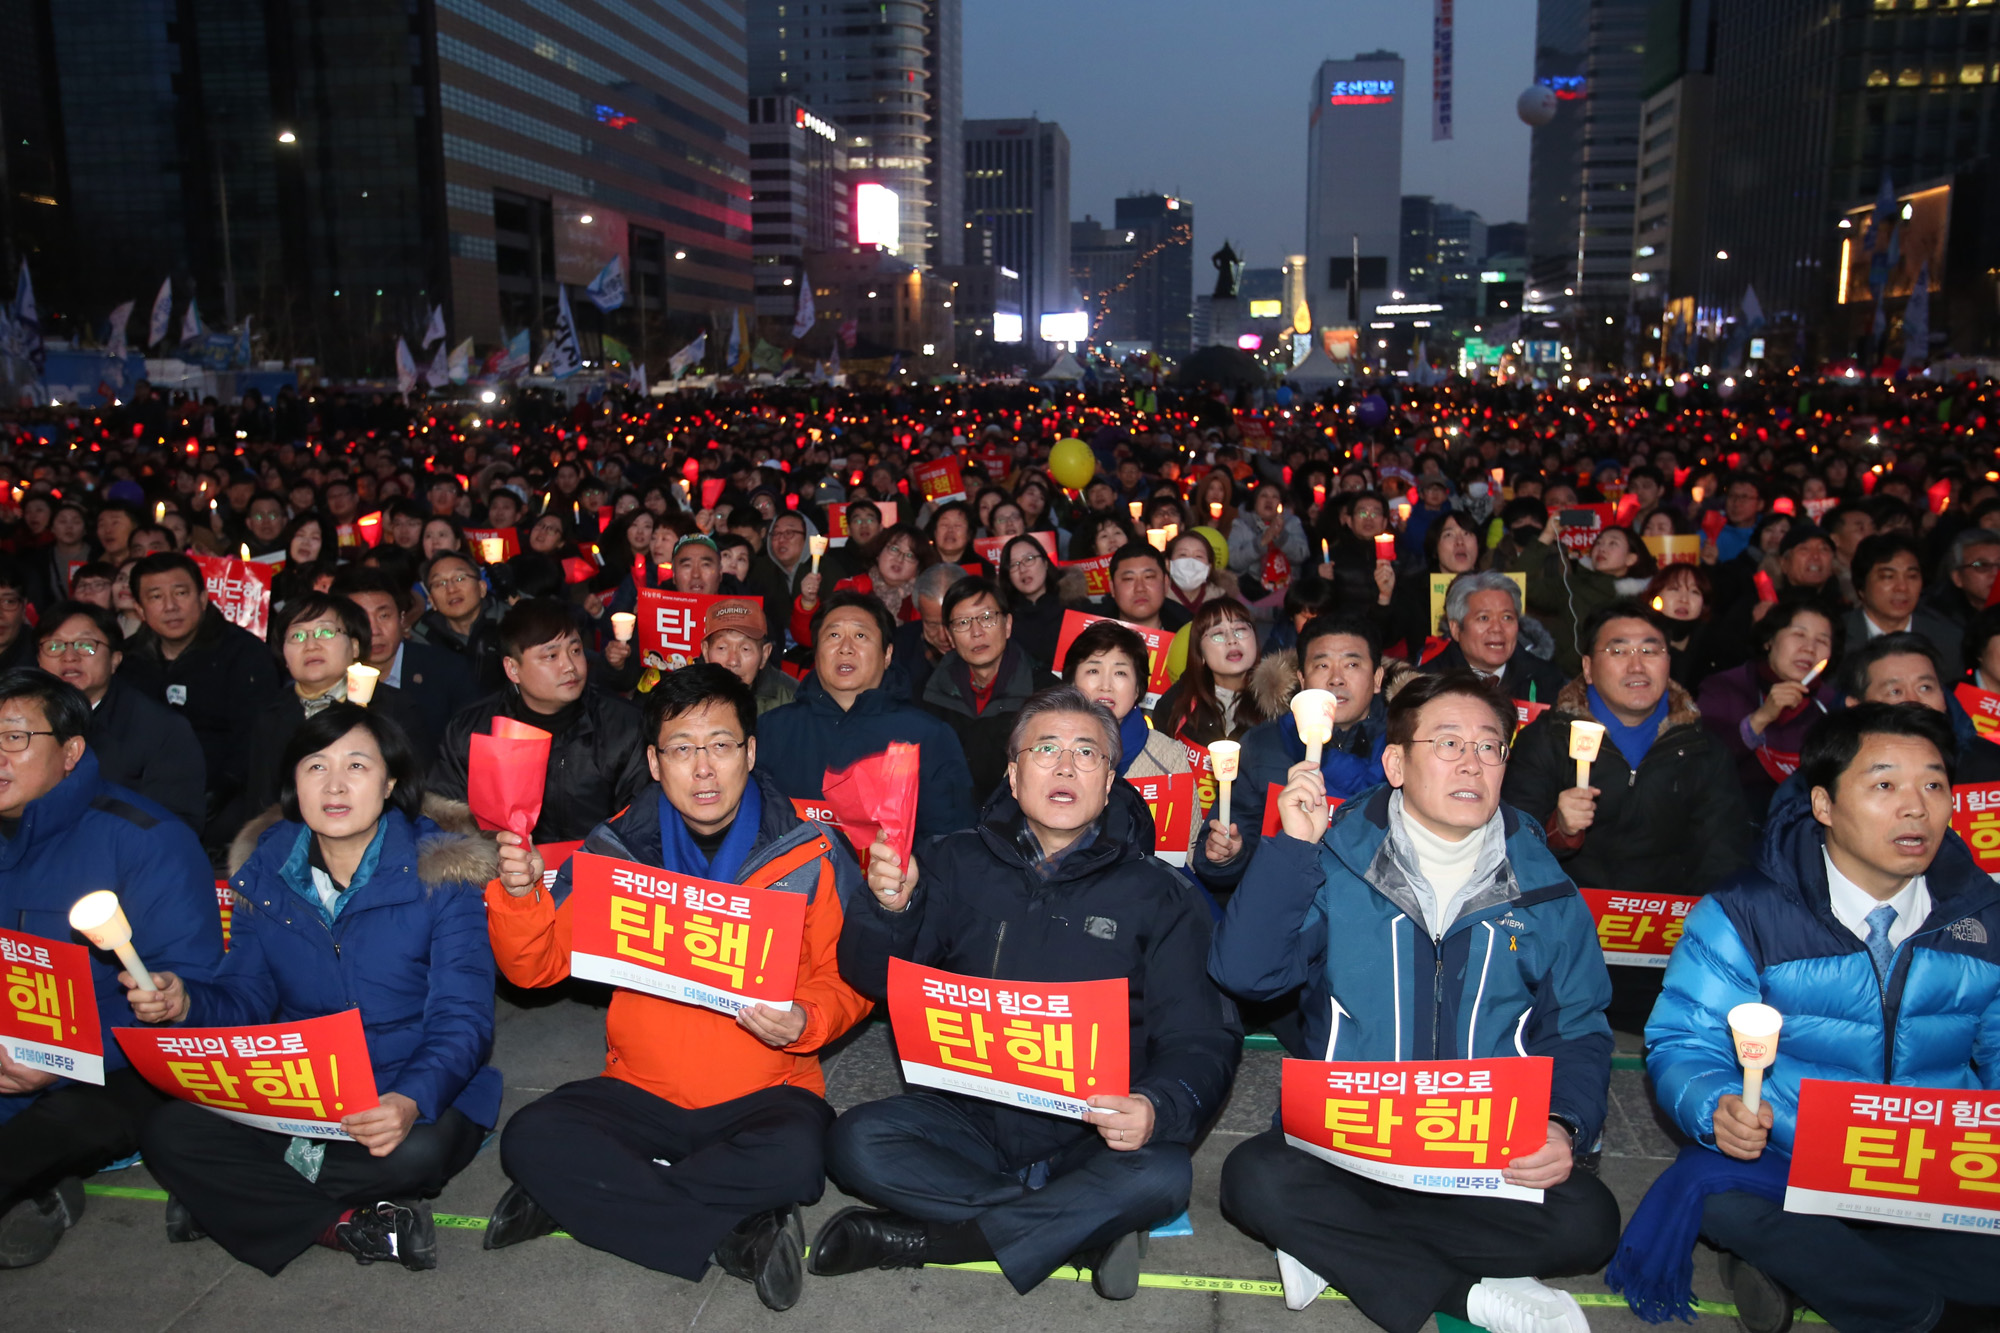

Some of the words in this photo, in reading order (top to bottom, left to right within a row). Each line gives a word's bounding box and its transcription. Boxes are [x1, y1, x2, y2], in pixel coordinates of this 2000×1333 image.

[1330, 79, 1395, 96] 조선일보
[206, 577, 263, 601] 박근혜
[716, 607, 748, 617] JOURNEY
[611, 868, 677, 905] 국민의
[683, 885, 751, 919] 힘으로
[1608, 897, 1667, 915] 국민의
[1504, 918, 1525, 930] NEPA
[0, 938, 54, 969] 힘으로
[610, 895, 774, 989] 탄핵!
[922, 978, 991, 1012] 국민의
[996, 990, 1072, 1017] 힘으로
[156, 1037, 229, 1058] 국민의
[231, 1033, 308, 1057] 힘으로
[925, 1007, 1099, 1093] 탄핵!
[14, 1046, 75, 1071] 더불어민주당
[167, 1054, 344, 1118] 탄핵!
[1327, 1071, 1406, 1094] 국민의
[1414, 1070, 1492, 1094] 힘으로
[1850, 1094, 1943, 1125] 국민의
[1325, 1097, 1518, 1163] 탄핵!
[1413, 1174, 1500, 1189] 더불어민주당
[1942, 1212, 2000, 1229] 더불어
